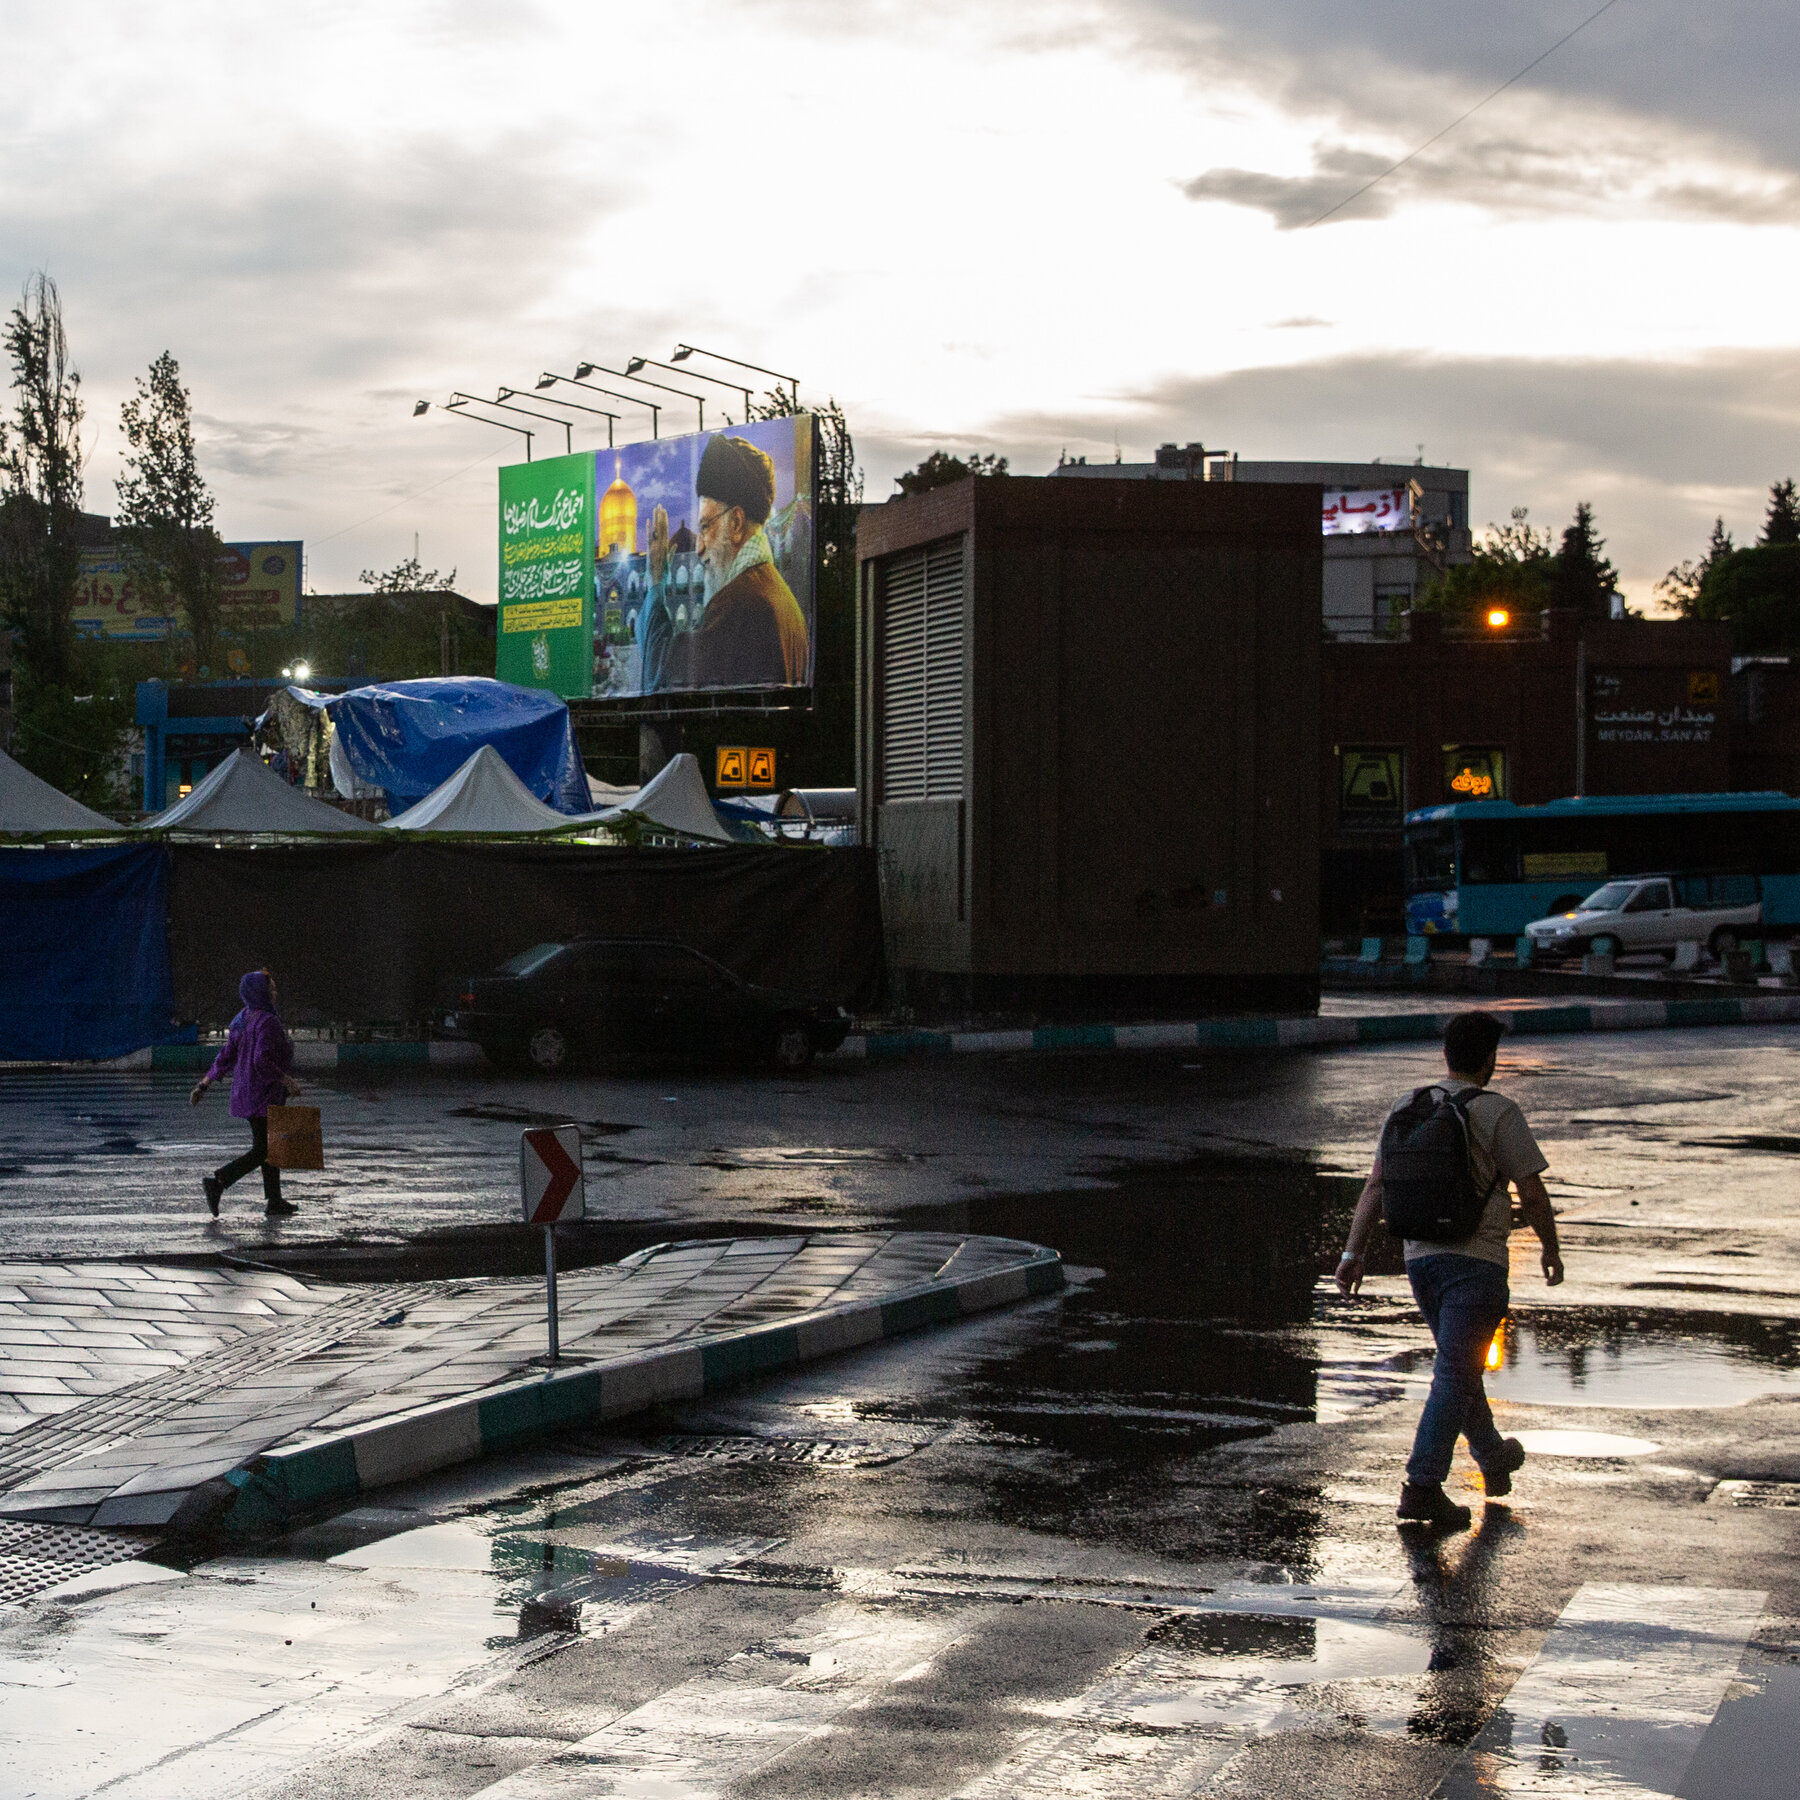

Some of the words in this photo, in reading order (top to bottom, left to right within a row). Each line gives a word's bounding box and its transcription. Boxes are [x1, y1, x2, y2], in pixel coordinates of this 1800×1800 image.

[535, 488, 564, 531] بزرگ
[560, 489, 585, 530] اجتماع
[1322, 490, 1405, 521] آزمای
[1594, 706, 1657, 723] صنعت
[1658, 705, 1716, 728] میدان
